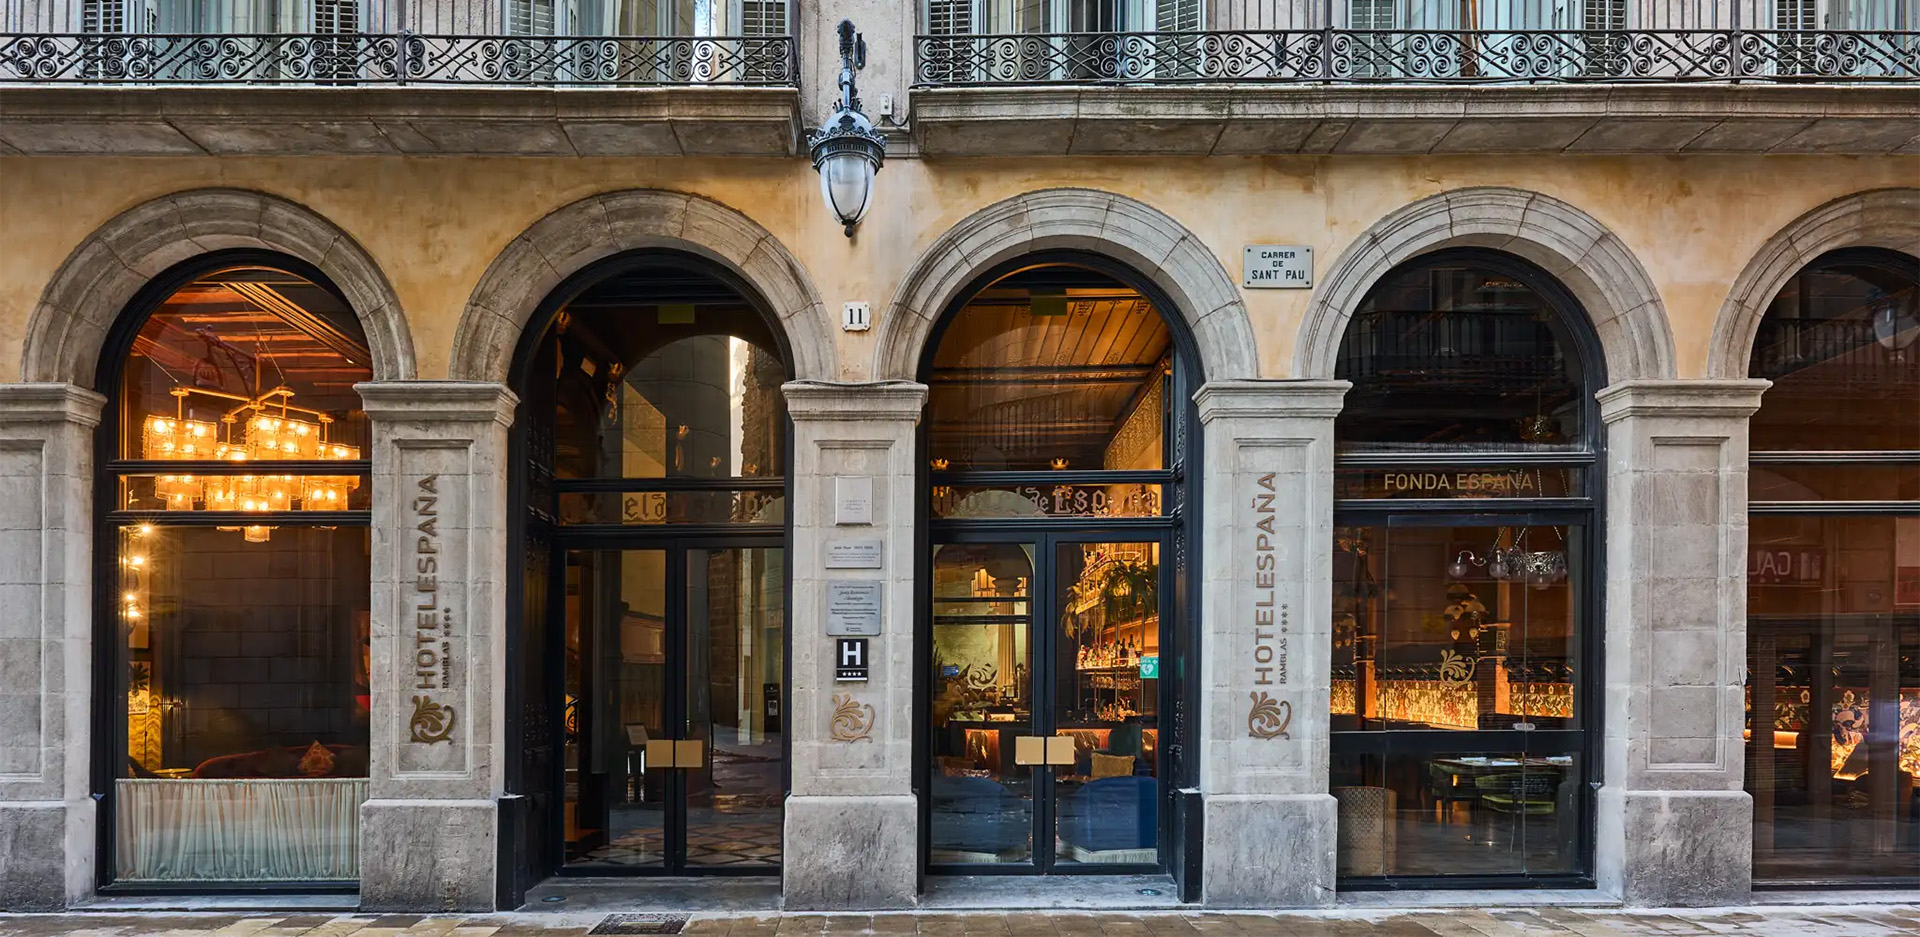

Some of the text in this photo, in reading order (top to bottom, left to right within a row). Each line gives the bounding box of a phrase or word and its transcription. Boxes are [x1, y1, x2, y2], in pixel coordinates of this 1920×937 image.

[1261, 251, 1296, 259] CARRER
[1272, 260, 1284, 268] DE
[1251, 269, 1305, 280] SANT PAU
[849, 308, 863, 325] 11
[1384, 469, 1533, 490] FONDA ESPAÑA
[1052, 485, 1160, 514] Espña
[842, 641, 862, 666] H
[1279, 638, 1287, 684] RAMBLAS
[442, 641, 450, 689] RAMBLAS
